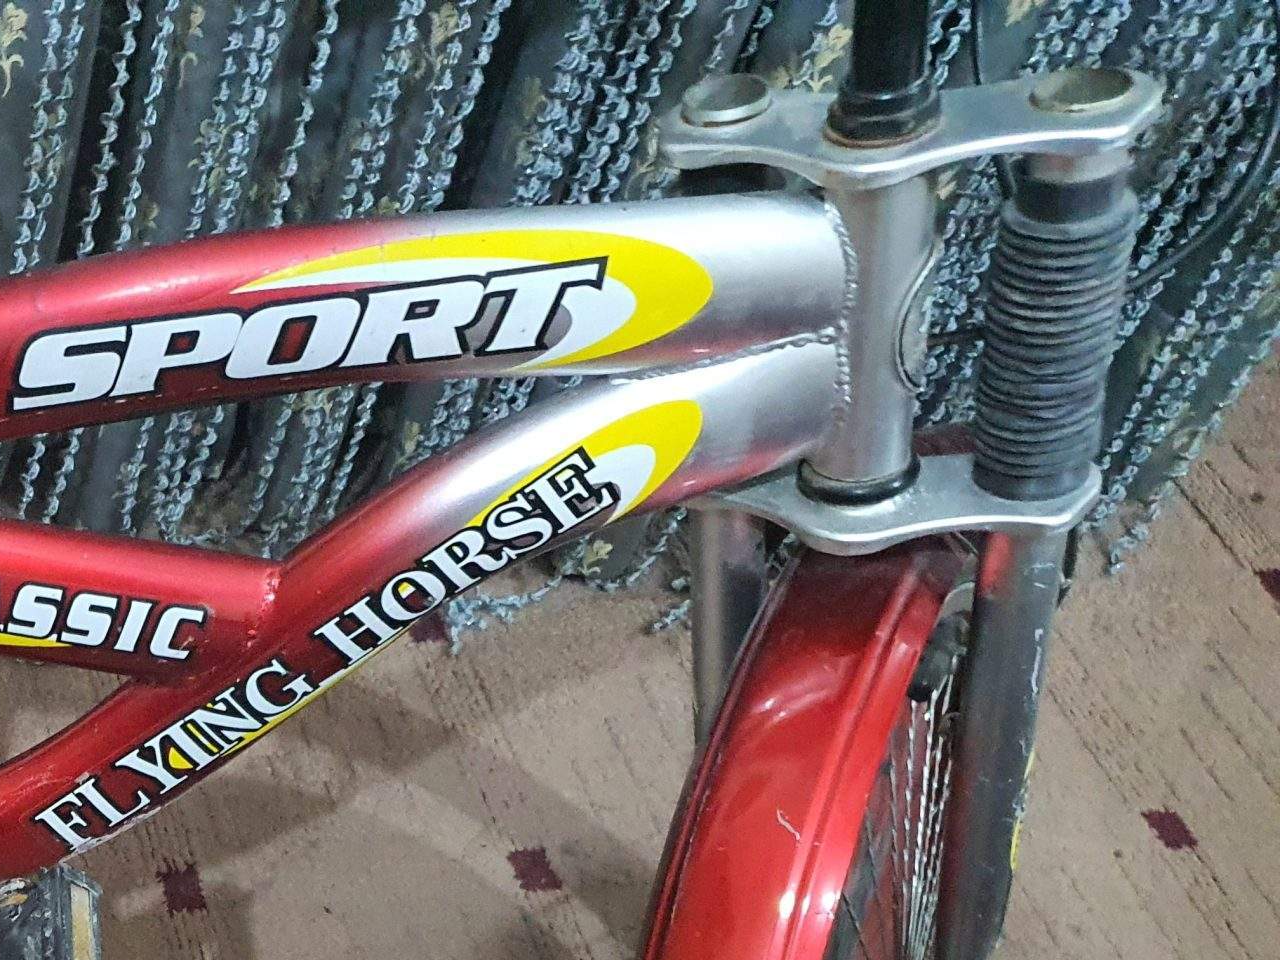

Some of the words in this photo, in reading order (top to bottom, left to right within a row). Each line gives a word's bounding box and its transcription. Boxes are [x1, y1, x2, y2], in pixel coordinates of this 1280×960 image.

[12, 256, 610, 411] SPORT
[31, 658, 322, 853] FLYING
[313, 445, 620, 667] HORSE
